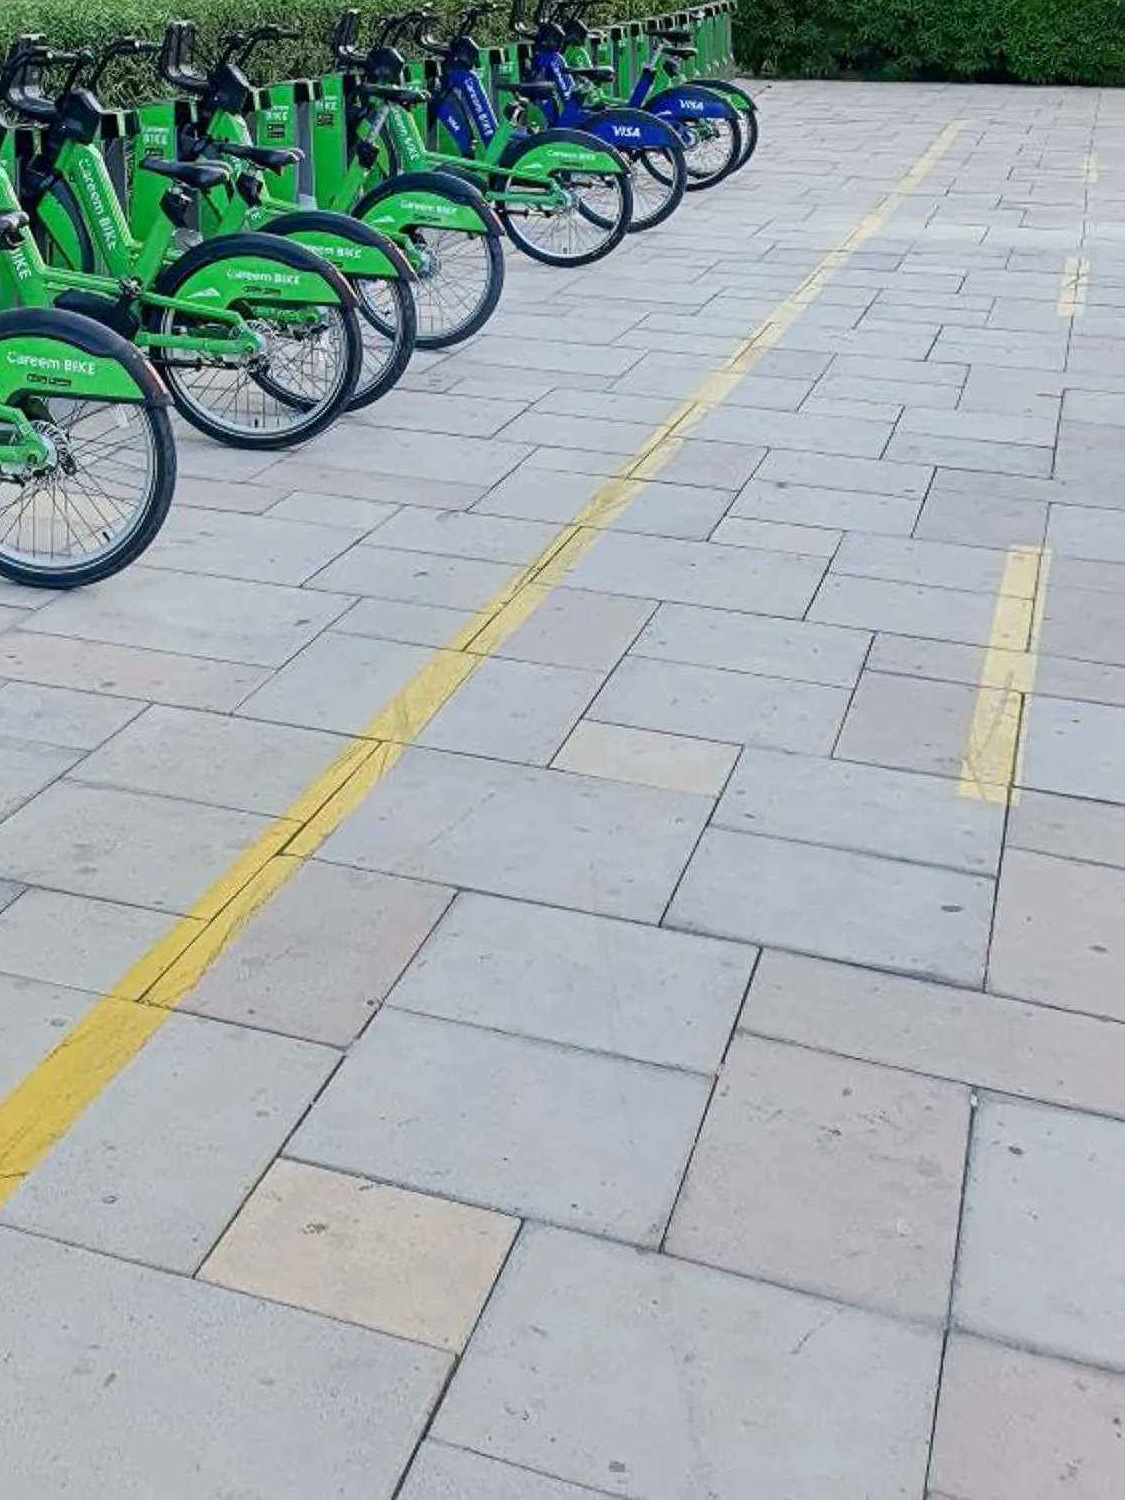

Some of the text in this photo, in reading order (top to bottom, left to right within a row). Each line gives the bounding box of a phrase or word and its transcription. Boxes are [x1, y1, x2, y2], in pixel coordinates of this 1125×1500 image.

[611, 125, 641, 137] VISA
[6, 351, 96, 375] Careem BIKE
